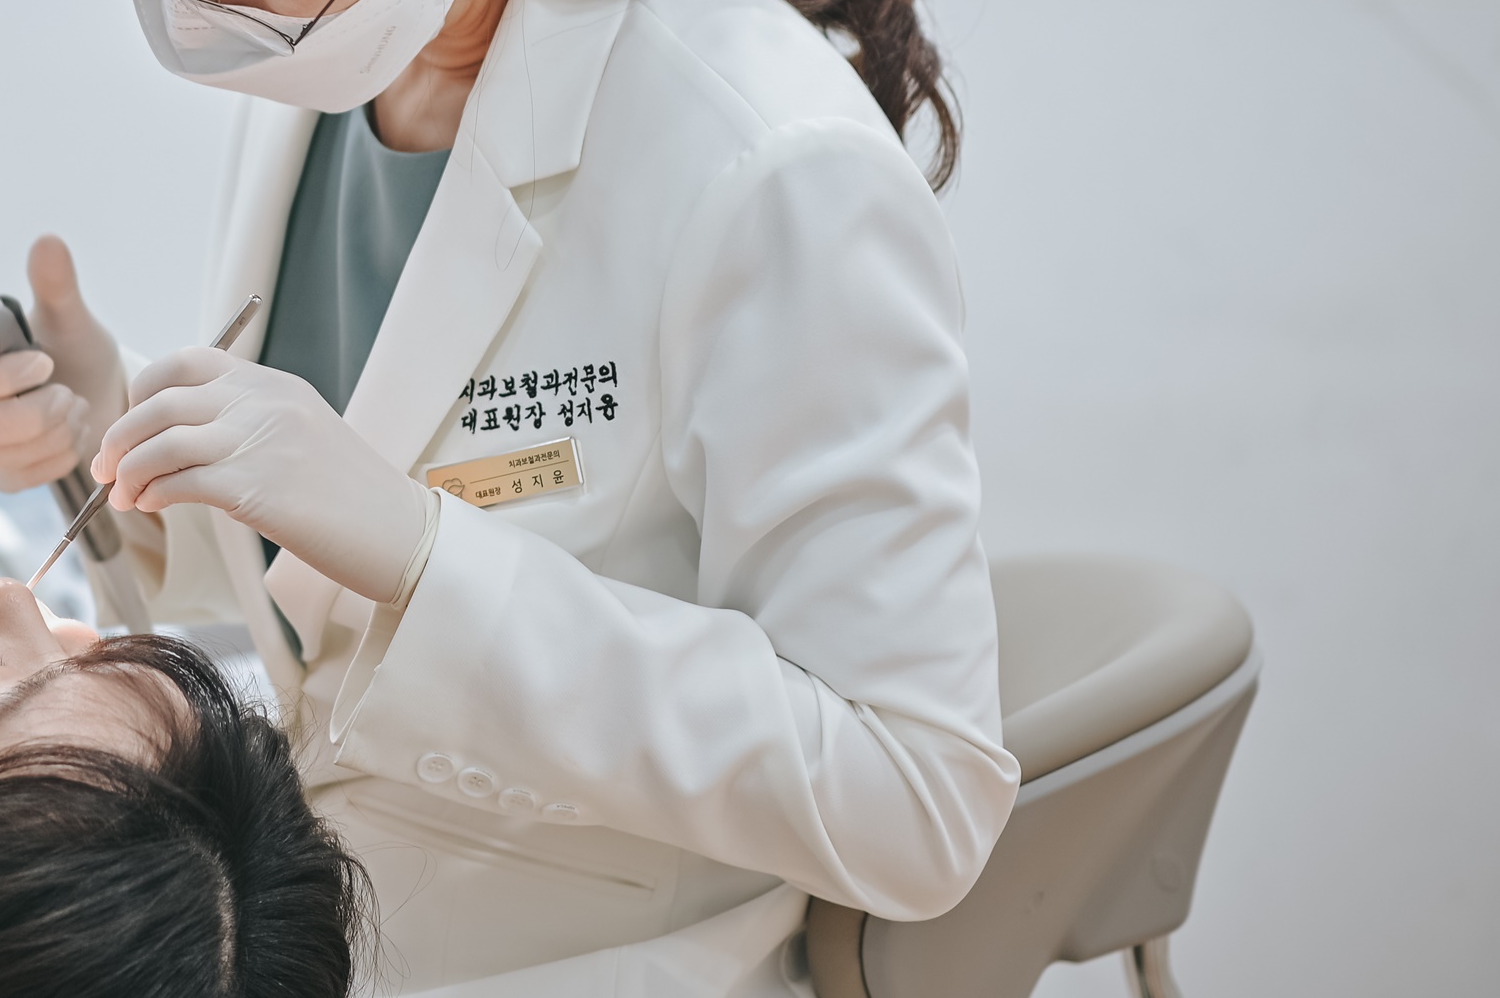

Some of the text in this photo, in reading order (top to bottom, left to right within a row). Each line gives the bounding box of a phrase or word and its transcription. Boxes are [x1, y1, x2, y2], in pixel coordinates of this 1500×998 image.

[461, 401, 546, 434] 대표원장
[508, 449, 561, 469] 치과보철과전문의
[475, 486, 501, 500] 대표원장
